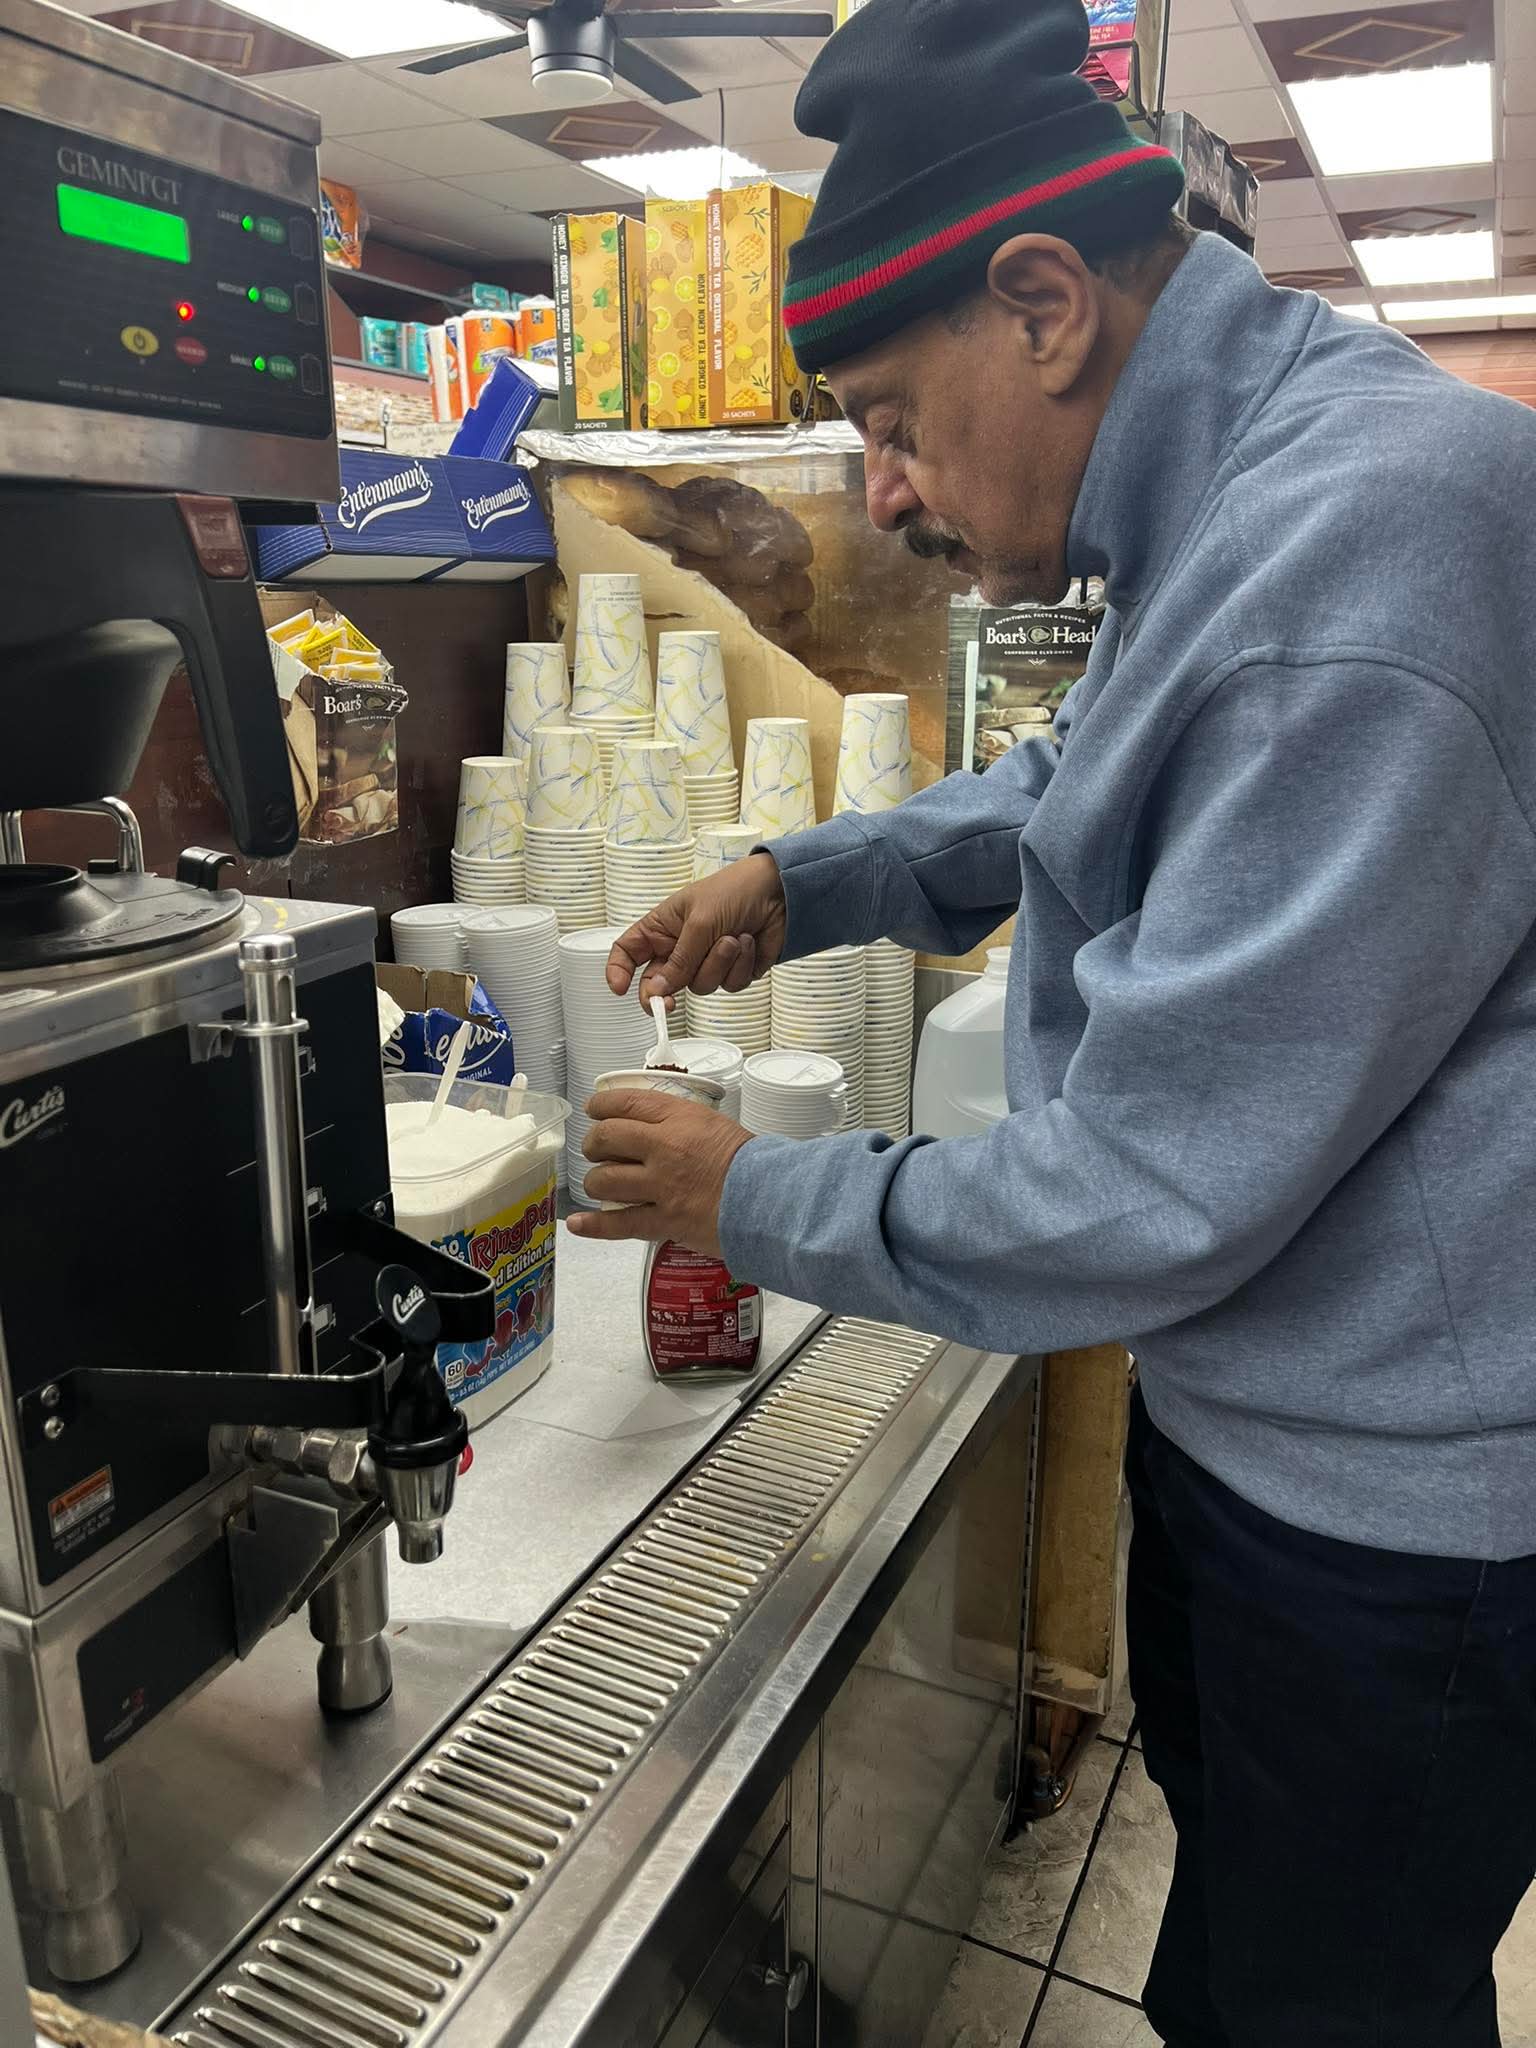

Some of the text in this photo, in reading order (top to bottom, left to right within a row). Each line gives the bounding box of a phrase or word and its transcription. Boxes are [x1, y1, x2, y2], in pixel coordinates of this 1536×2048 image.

[712, 203, 721, 231] HONEY
[713, 235, 721, 268] GINGER
[713, 271, 721, 289] TEA
[558, 224, 573, 386] HONEY GINGER TEA GREEN TEA FLAVOR
[697, 273, 707, 419] HONEY GINGER TEA LEMON FLAVOR
[714, 339, 722, 370] FLAVOR
[574, 422, 582, 430] 20
[730, 410, 756, 418] SACHETS
[338, 460, 433, 529] Entenmann's
[462, 478, 531, 530] Entenmann's
[1060, 614, 1086, 624] RECIPES
[986, 625, 1096, 644] Boar's Head
[323, 693, 362, 715] Boar's
[506, 1245, 543, 1281] Edition
[392, 1284, 426, 1324] Curtis
[447, 1361, 462, 1377] 60
